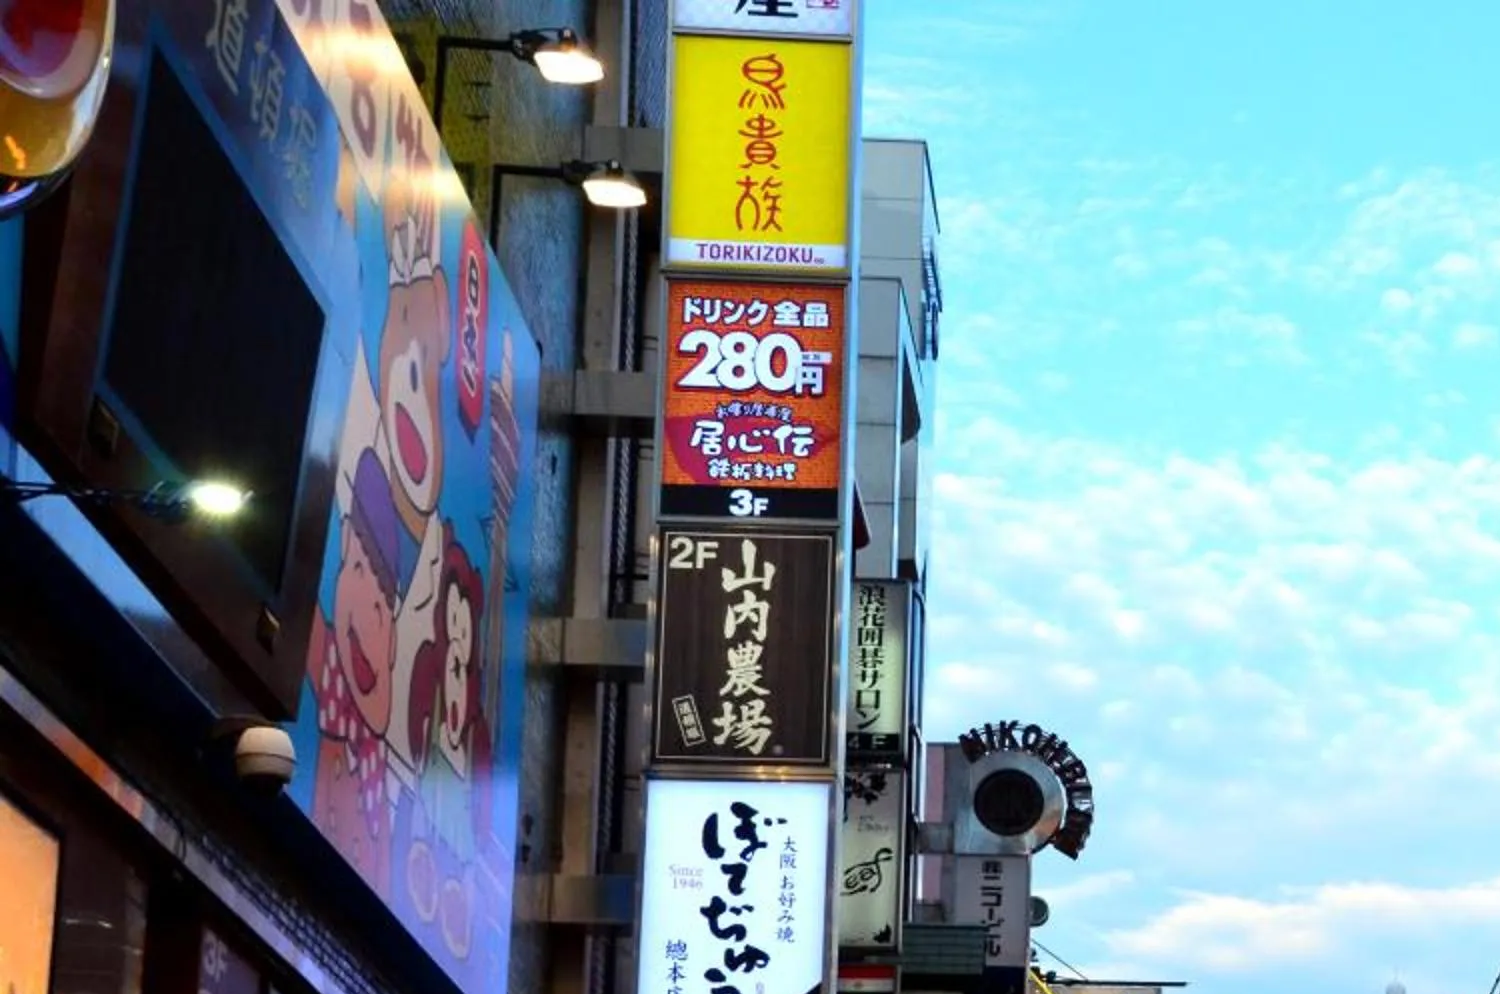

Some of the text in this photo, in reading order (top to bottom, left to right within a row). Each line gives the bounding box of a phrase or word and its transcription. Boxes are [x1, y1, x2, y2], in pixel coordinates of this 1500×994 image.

[735, 53, 786, 232] 鳥貴族
[696, 243, 814, 264] TORIKIZOKU
[678, 330, 831, 396] 280円
[690, 420, 815, 457] 居心伝
[728, 489, 769, 517] 3F
[669, 538, 718, 570] 2F
[712, 539, 775, 755] 山内農場
[857, 583, 886, 731] 浪花囲碁サロン
[669, 864, 704, 878] Since
